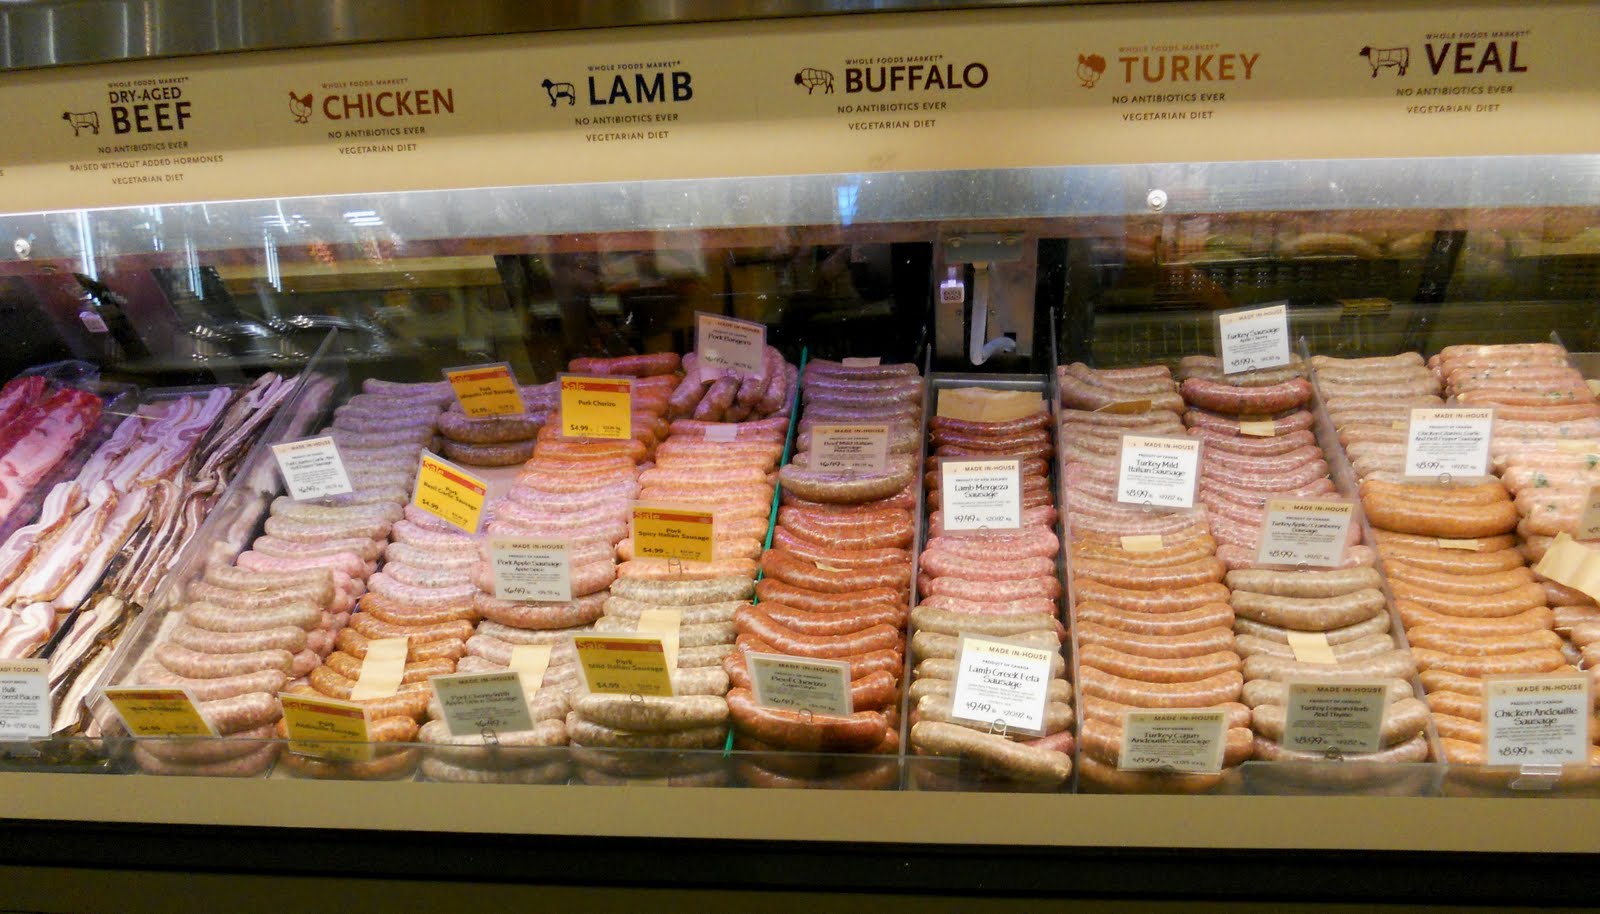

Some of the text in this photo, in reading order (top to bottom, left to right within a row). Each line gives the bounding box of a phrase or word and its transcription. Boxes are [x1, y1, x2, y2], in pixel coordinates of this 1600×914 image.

[877, 56, 904, 64] FOODS
[1425, 41, 1527, 75] VEAL
[1119, 53, 1261, 83] TURKEY
[845, 62, 988, 93] BUFFALO
[588, 71, 693, 105] LAMB
[1396, 85, 1513, 96] NO ANTIBIOTICS EVER
[109, 87, 181, 104] DRY-AGED
[1112, 93, 1225, 104] NO ANTIBIOTICS EVER
[322, 88, 454, 120] CHICKEN
[838, 101, 947, 114] NO ANTIBIOTICS EVER
[1407, 104, 1500, 114] VEGETARIAN DIET
[111, 101, 192, 134] BEEF
[575, 113, 678, 126] NO ANTIBIOTICS EVER
[1122, 111, 1213, 121] VEGETARIAN DIET
[848, 119, 936, 131] VEGETARIAN DIET
[328, 126, 426, 139] NO ANTIBIOTICS EVER
[586, 131, 669, 142] VEGETARIAN DIET
[114, 143, 165, 152] ANTIBIOTICS
[168, 141, 188, 149] EVER
[339, 144, 417, 155] VEGETARIAN DIET
[70, 155, 223, 171] RAISED WITHOUT ADDED HORMONES
[112, 174, 184, 185] VEGETARIAN DIET
[1227, 332, 1249, 340] Turkey
[563, 382, 585, 390] Sale
[1136, 459, 1161, 469] Turkey
[1152, 468, 1186, 477] Sausage
[989, 646, 1047, 661] MADE IN-HOUSE
[968, 665, 1039, 683] Lamb Greek Feta
[983, 675, 1022, 689] Sausage
[1495, 707, 1578, 718] Chicken Andouille
[1514, 718, 1557, 727] Sausage
